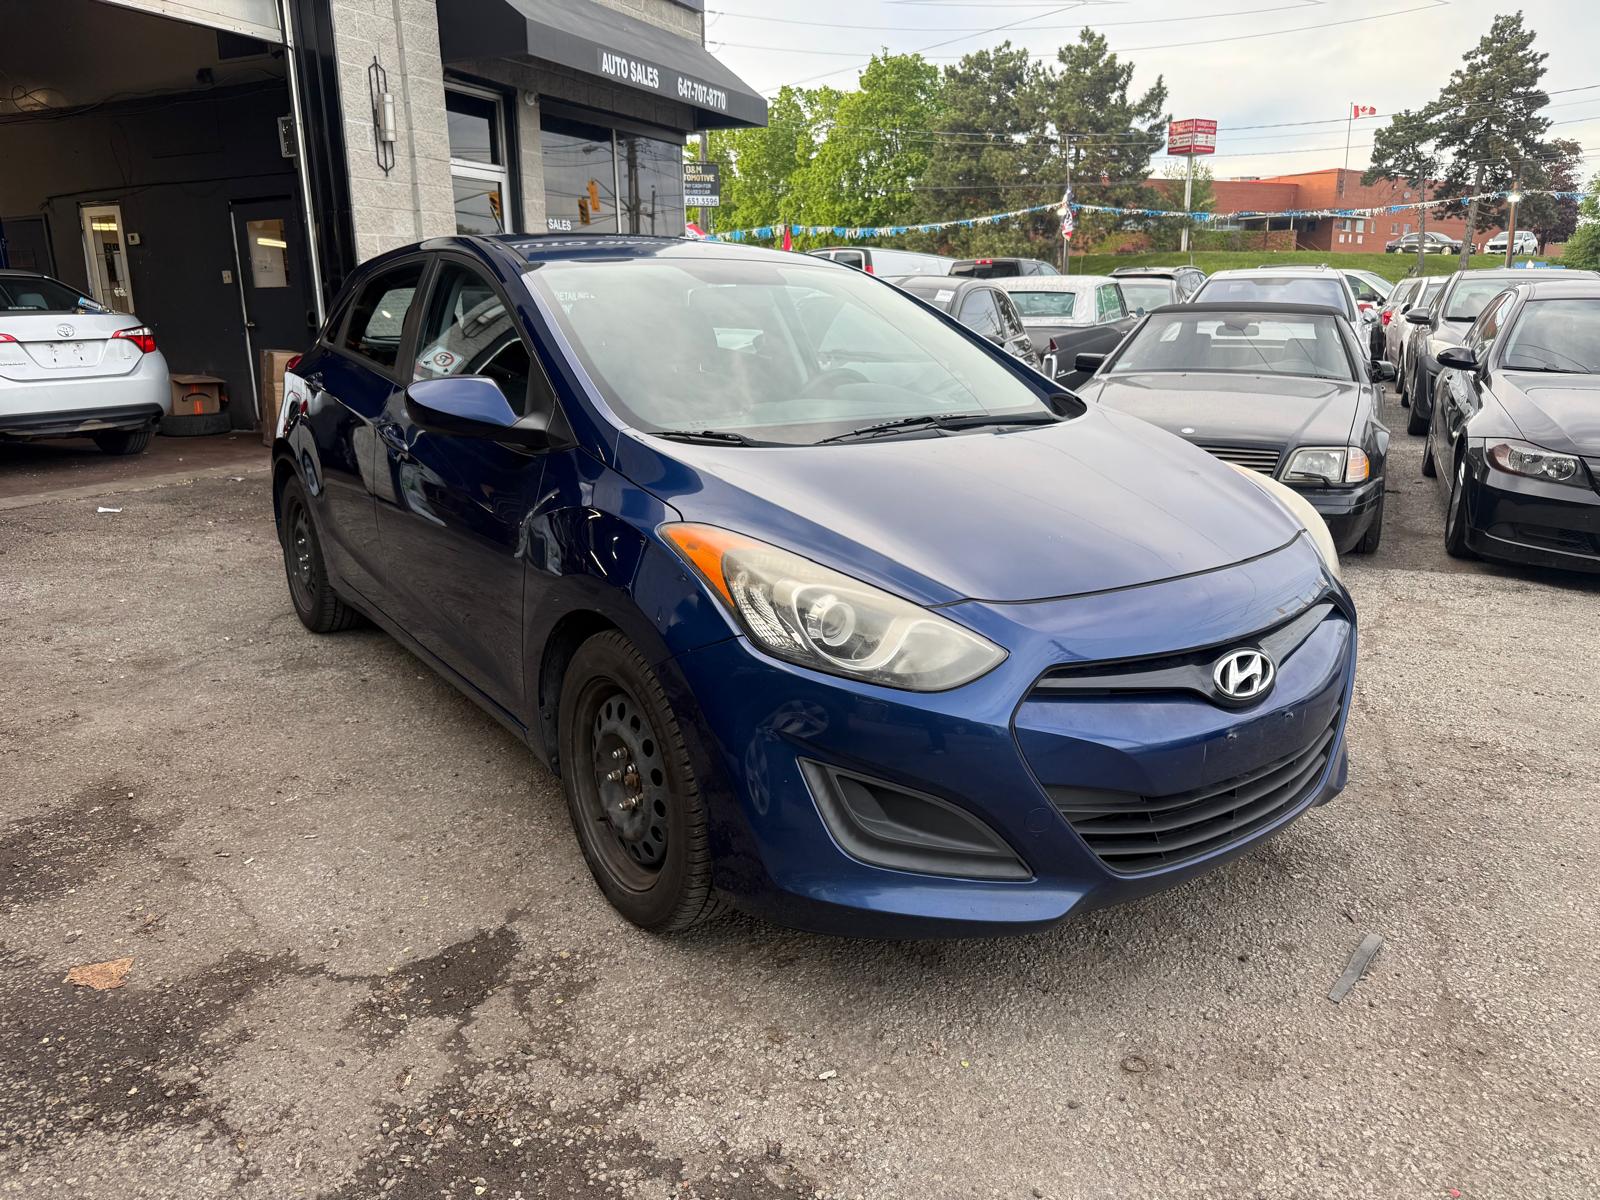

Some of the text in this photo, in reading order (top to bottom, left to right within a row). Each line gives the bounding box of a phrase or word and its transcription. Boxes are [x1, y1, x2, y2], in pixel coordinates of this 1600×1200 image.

[602, 52, 659, 89] AUTO SALES
[677, 77, 726, 110] 647-707-8770
[548, 218, 572, 231] SALES
